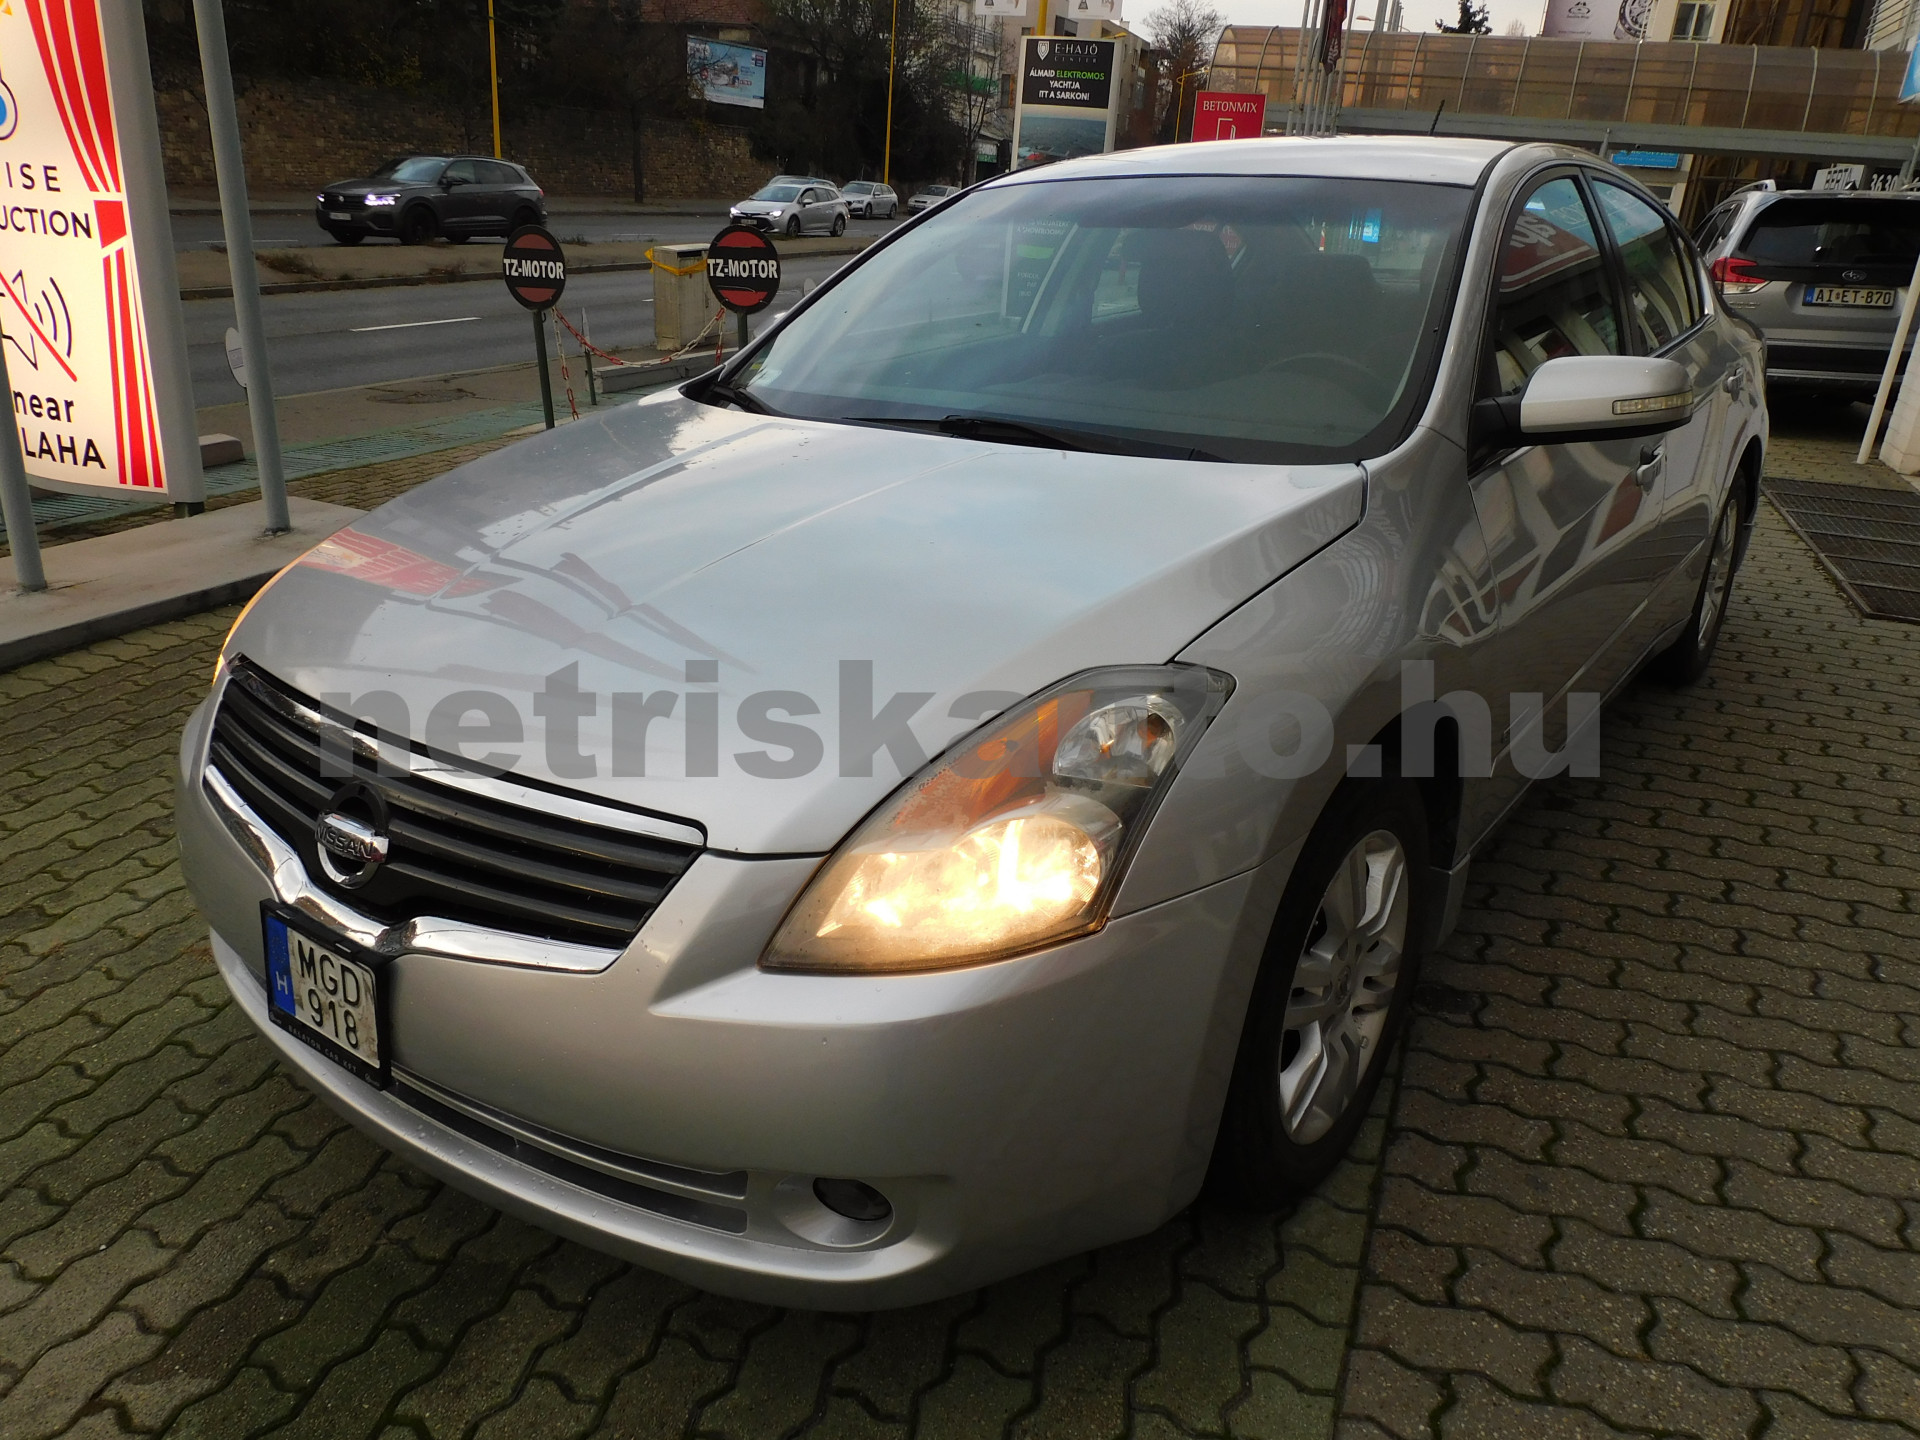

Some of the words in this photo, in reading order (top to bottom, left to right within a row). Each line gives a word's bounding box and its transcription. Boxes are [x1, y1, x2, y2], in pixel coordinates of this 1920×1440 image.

[1029, 66, 1056, 78] ÁLMAID
[1056, 69, 1105, 81] ELEKTROMOS
[1049, 80, 1081, 90] YACHTJA
[1038, 90, 1049, 99] ITT
[1048, 91, 1056, 99] A
[1056, 91, 1090, 101] SARKON!
[1203, 100, 1258, 113] BETONMIX
[503, 257, 565, 280] TZ-MOTOR
[707, 257, 778, 280] TZ-MOTOR
[13, 389, 75, 424] near
[316, 824, 374, 860] NISSAN
[275, 970, 289, 996] H
[297, 939, 361, 1007] MGD
[307, 987, 360, 1050] 918
